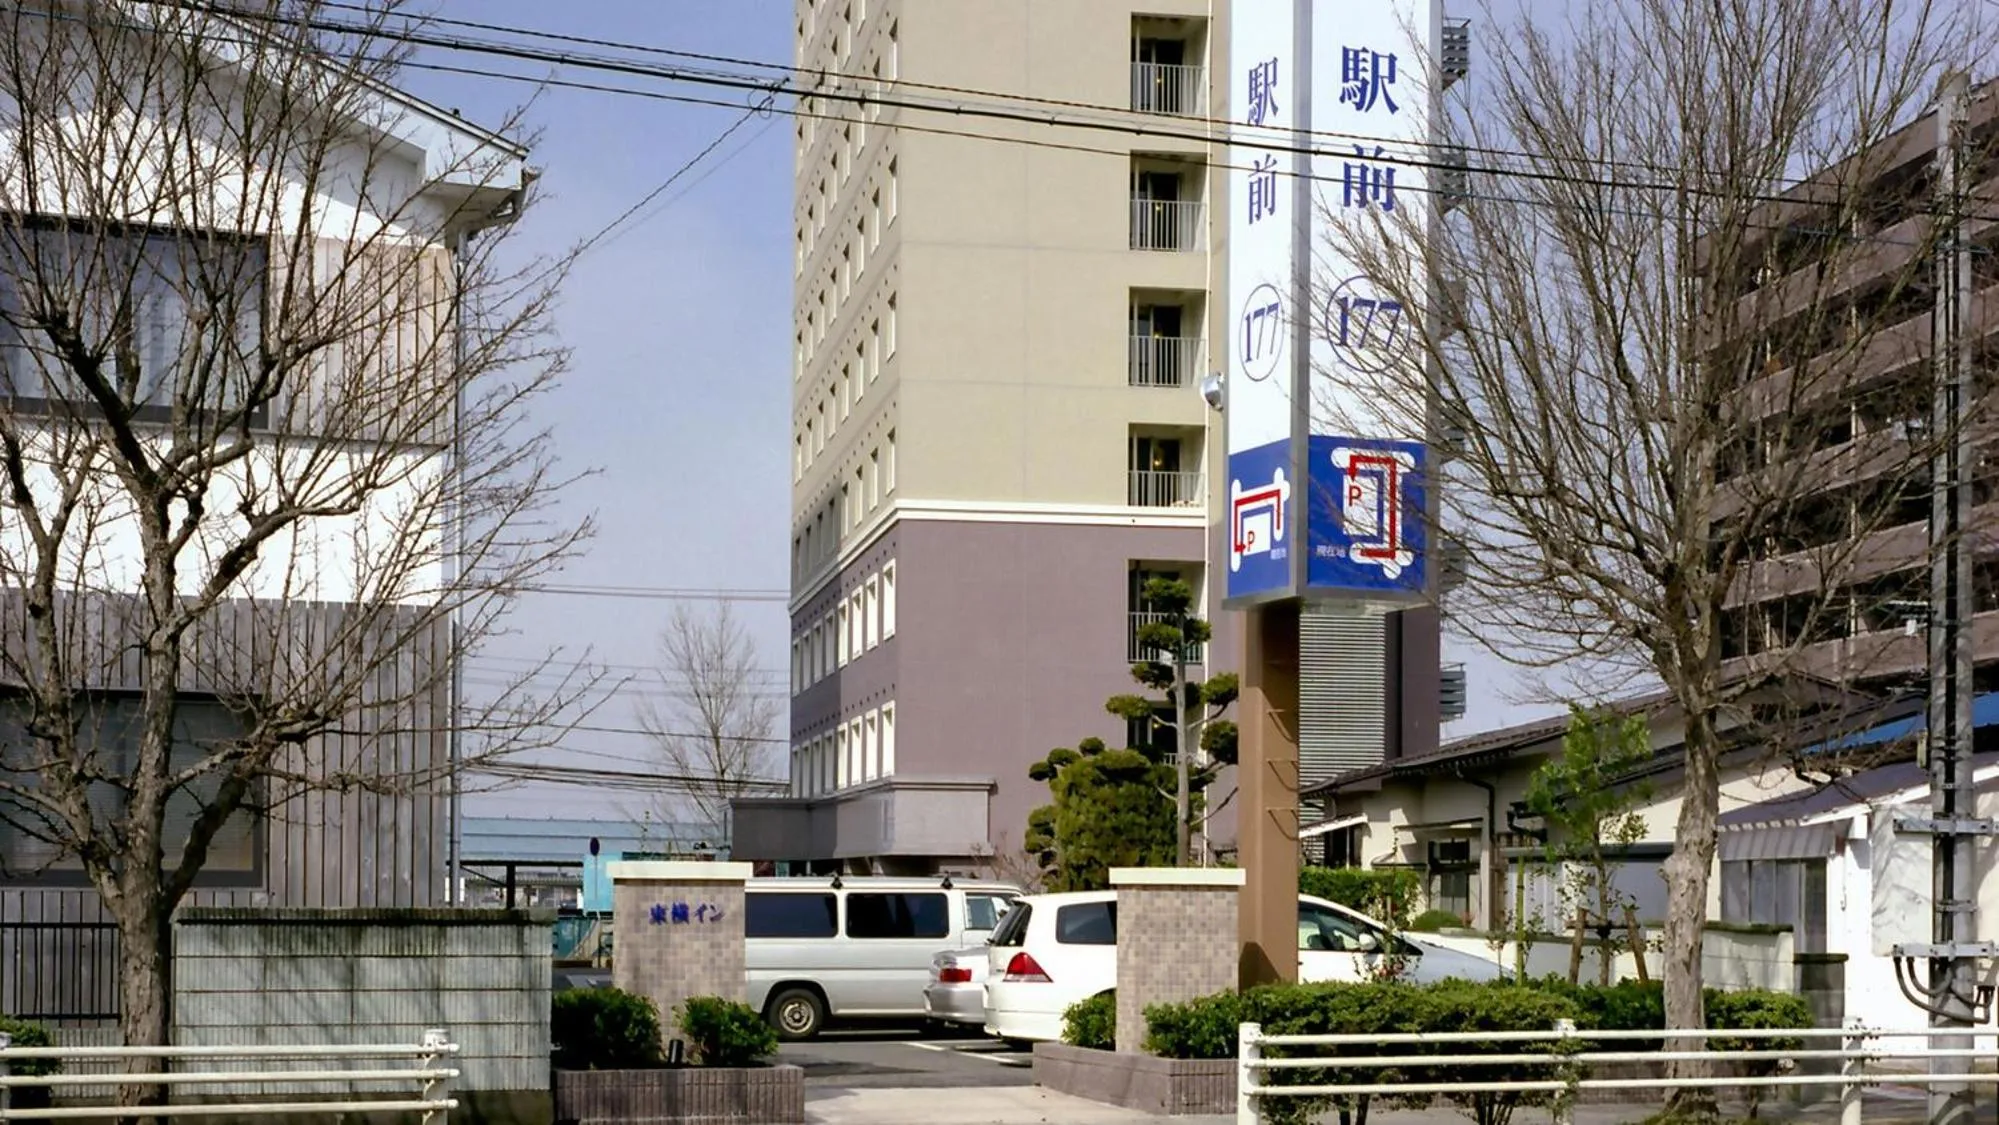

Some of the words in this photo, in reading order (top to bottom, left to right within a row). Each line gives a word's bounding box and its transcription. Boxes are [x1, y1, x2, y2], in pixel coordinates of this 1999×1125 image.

[1248, 57, 1279, 225] 駅前
[1340, 46, 1399, 212] 駅前
[1245, 302, 1279, 363] 177
[1336, 297, 1402, 350] 177
[1349, 485, 1362, 507] P
[1247, 530, 1255, 552] P
